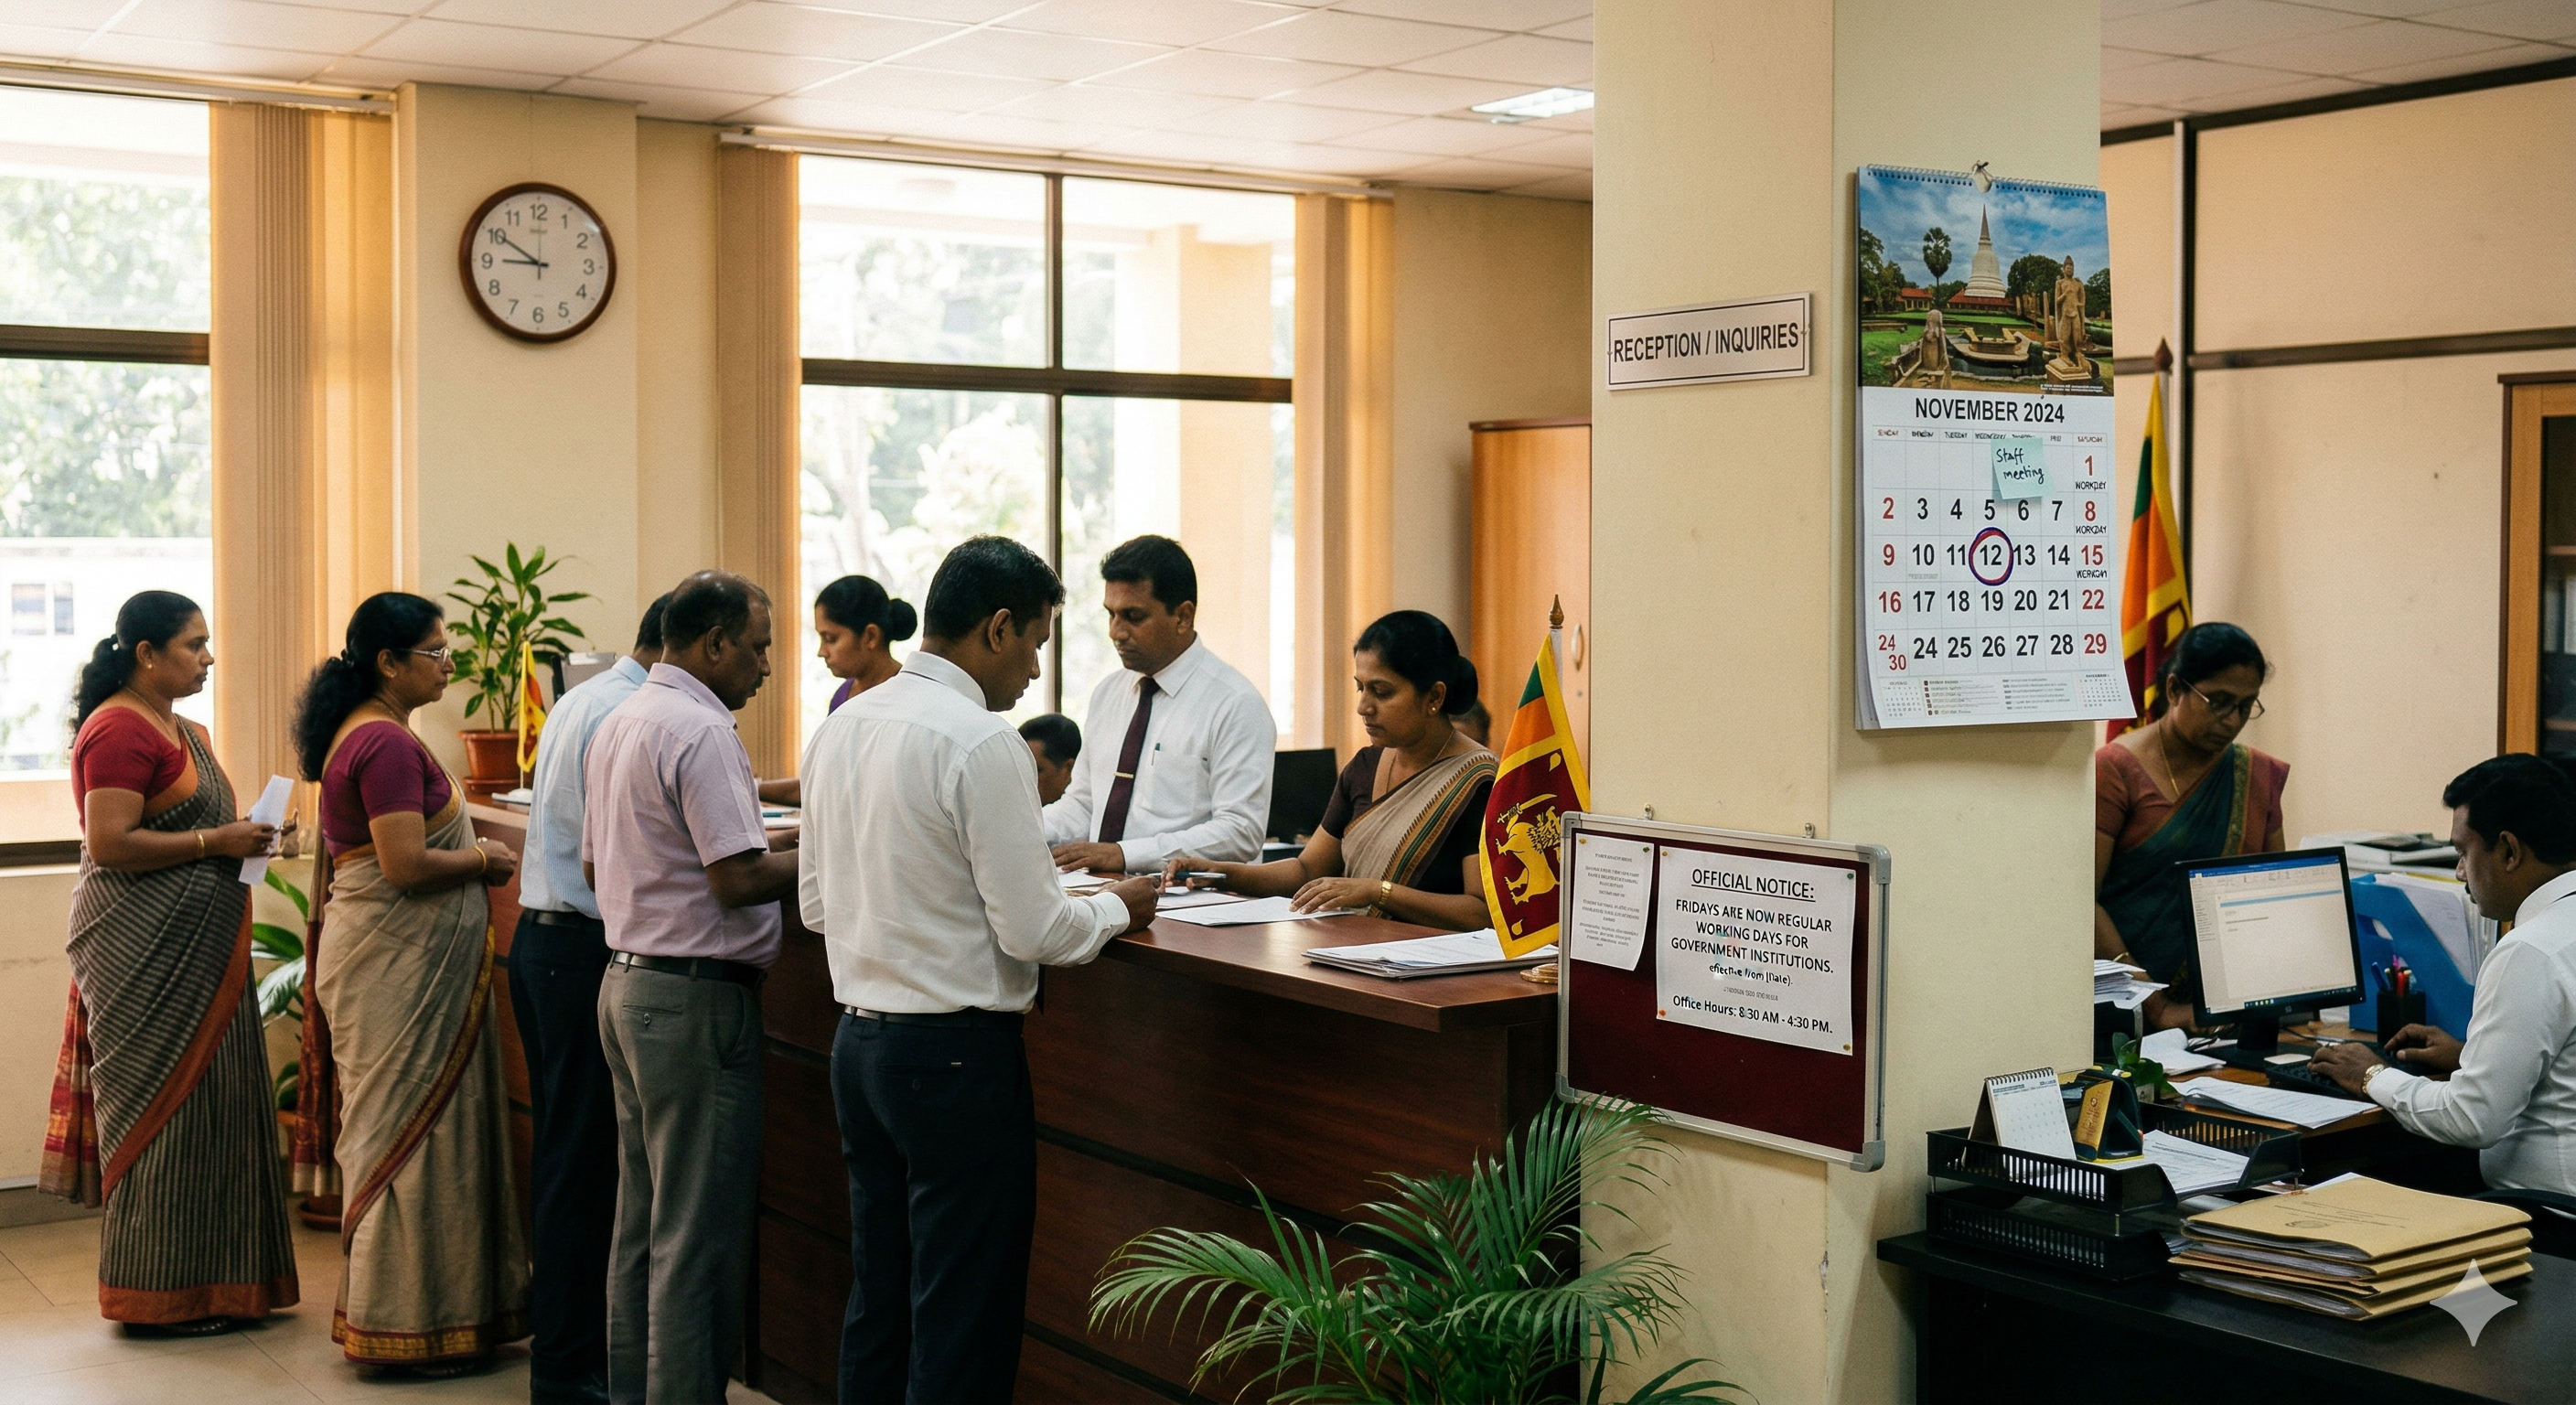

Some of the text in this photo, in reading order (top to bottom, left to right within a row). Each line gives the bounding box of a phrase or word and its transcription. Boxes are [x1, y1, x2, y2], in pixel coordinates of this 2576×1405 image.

[506, 209, 520, 226] 11
[531, 204, 547, 220] 12
[562, 214, 567, 228] 1
[577, 232, 588, 249] 2
[481, 252, 493, 269] 9
[584, 259, 595, 275] 3
[488, 279, 500, 295] 8
[576, 284, 586, 298] 4
[509, 299, 519, 314] 7
[532, 307, 544, 323] 6
[558, 302, 569, 317] 5
[1615, 323, 1798, 361] RECEPTION / INQUIRIES
[1916, 398, 2064, 423] NOVEMBER 2024
[1996, 448, 2023, 465] Staff
[2086, 456, 2092, 476] 1
[2003, 466, 2044, 484] meeting
[1884, 498, 2096, 521] 2 3 4 5 6 7 8
[1884, 544, 2103, 565] 9 10 11 12 13 14 15
[1879, 589, 2104, 612] 16 17 18 19 20 21 22
[1879, 635, 1895, 650] 24
[1914, 634, 2107, 659] 24 25 26 27 28 29
[1889, 655, 1906, 670] 30
[1692, 869, 1814, 898] OFFICIAL NOTICE:
[1677, 899, 1831, 931] FRIDAYS ARE NOW REGULAR
[1696, 922, 1808, 949] WORKING DAYS FOR
[1671, 938, 1833, 973] GOVERNMENT INSTITUTIONS.
[1673, 995, 1701, 1010] Office
[1705, 1001, 1736, 1016] Hours:
[1762, 1012, 1778, 1024] AM
[1787, 1016, 1809, 1029] 4:30
[1812, 1020, 1832, 1033] PM.
